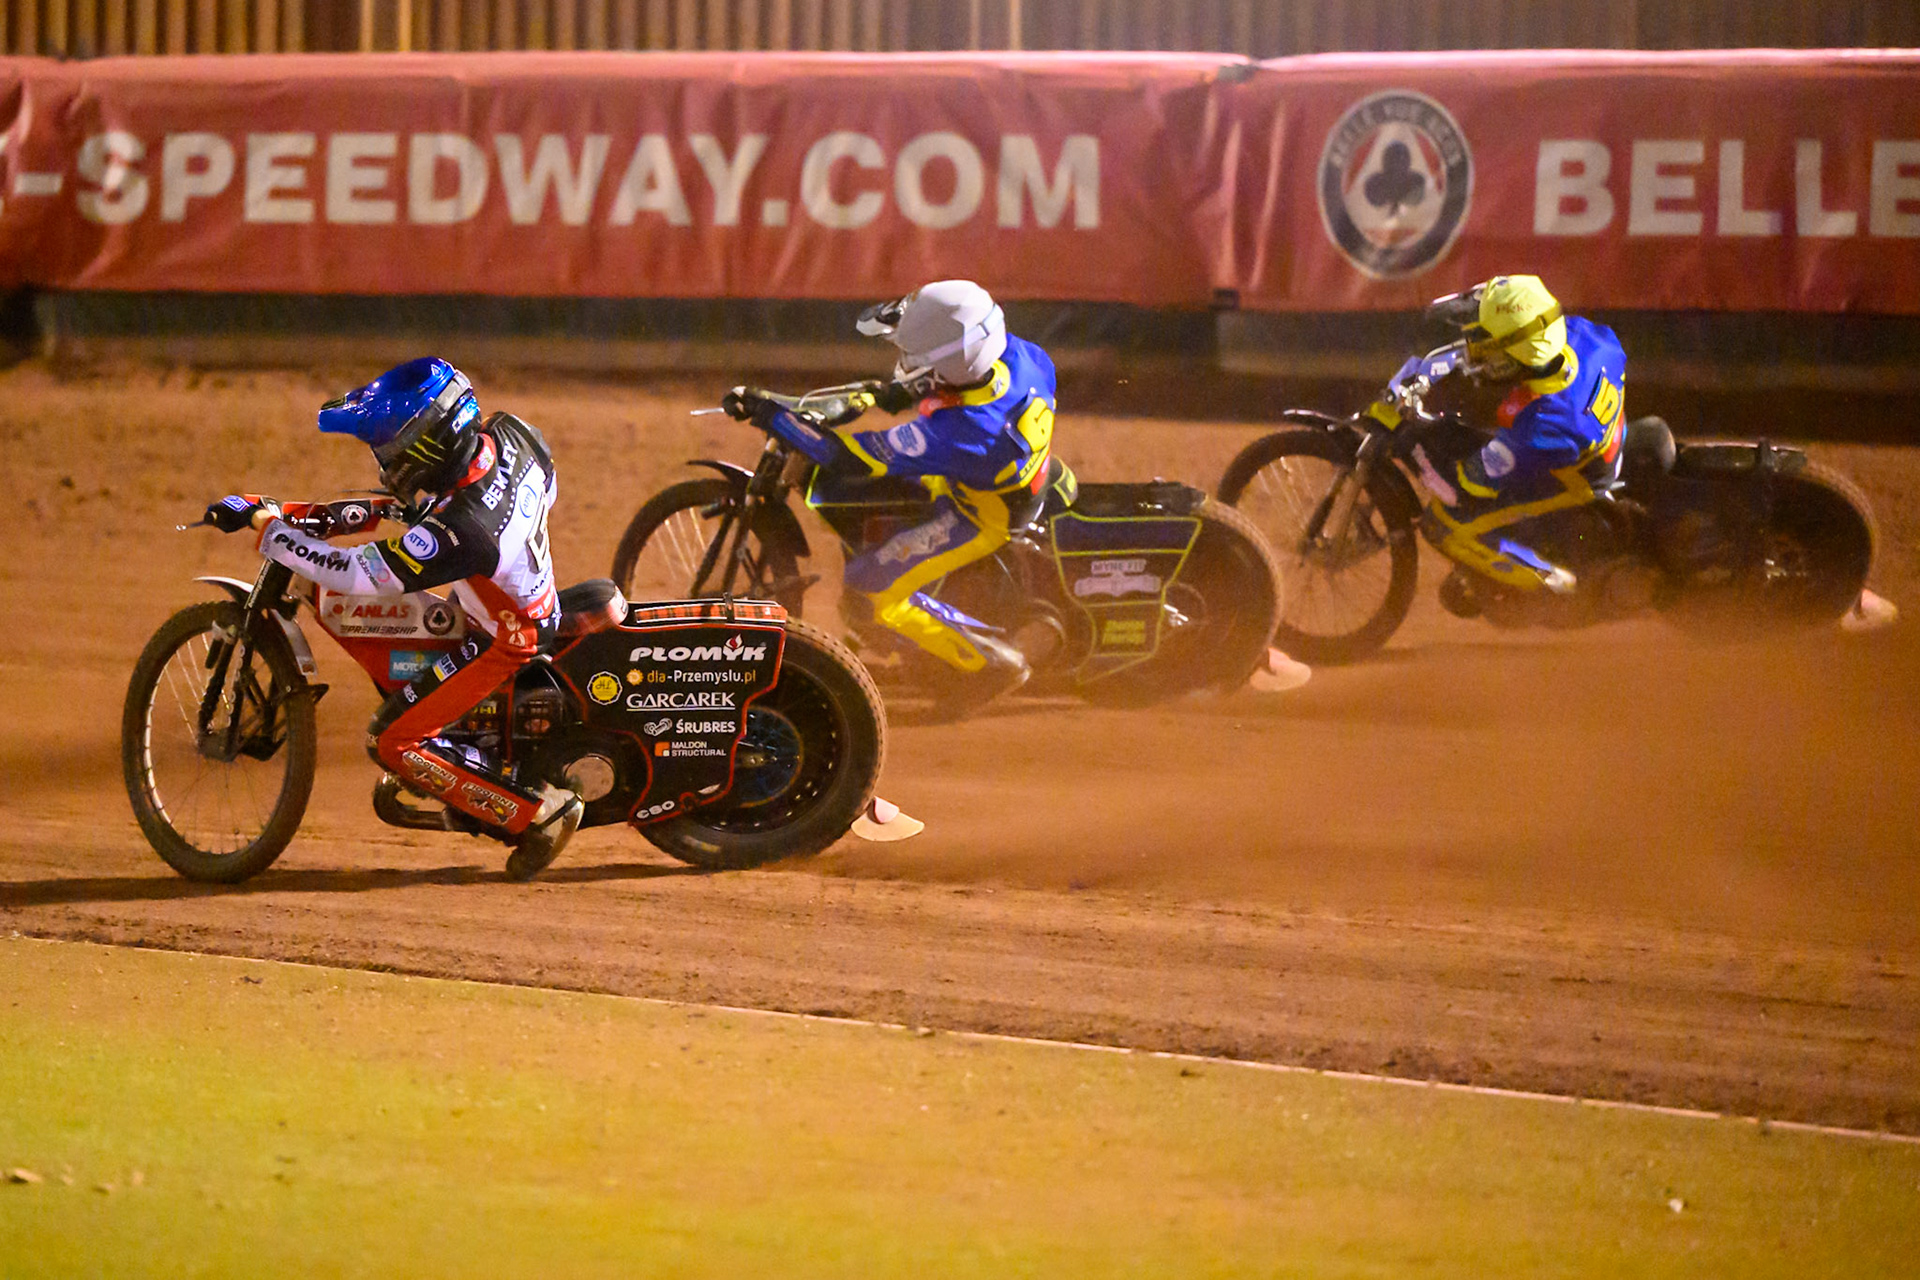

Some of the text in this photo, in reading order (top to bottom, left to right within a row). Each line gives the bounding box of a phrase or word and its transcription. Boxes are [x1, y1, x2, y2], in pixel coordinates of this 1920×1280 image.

[0, 131, 1101, 229] -SPEEDWAY.COM
[1533, 139, 1920, 238] BELLE
[481, 439, 518, 511] BEWLEY
[406, 532, 430, 552] ATPI
[351, 604, 411, 619] ANLAS
[647, 669, 756, 685] dla-Przemyslu.pl
[626, 692, 735, 708] GARCAREK
[676, 719, 736, 733] ŚRUBRES
[672, 741, 707, 749] MALDON
[672, 748, 727, 757] STRUCTURAL
